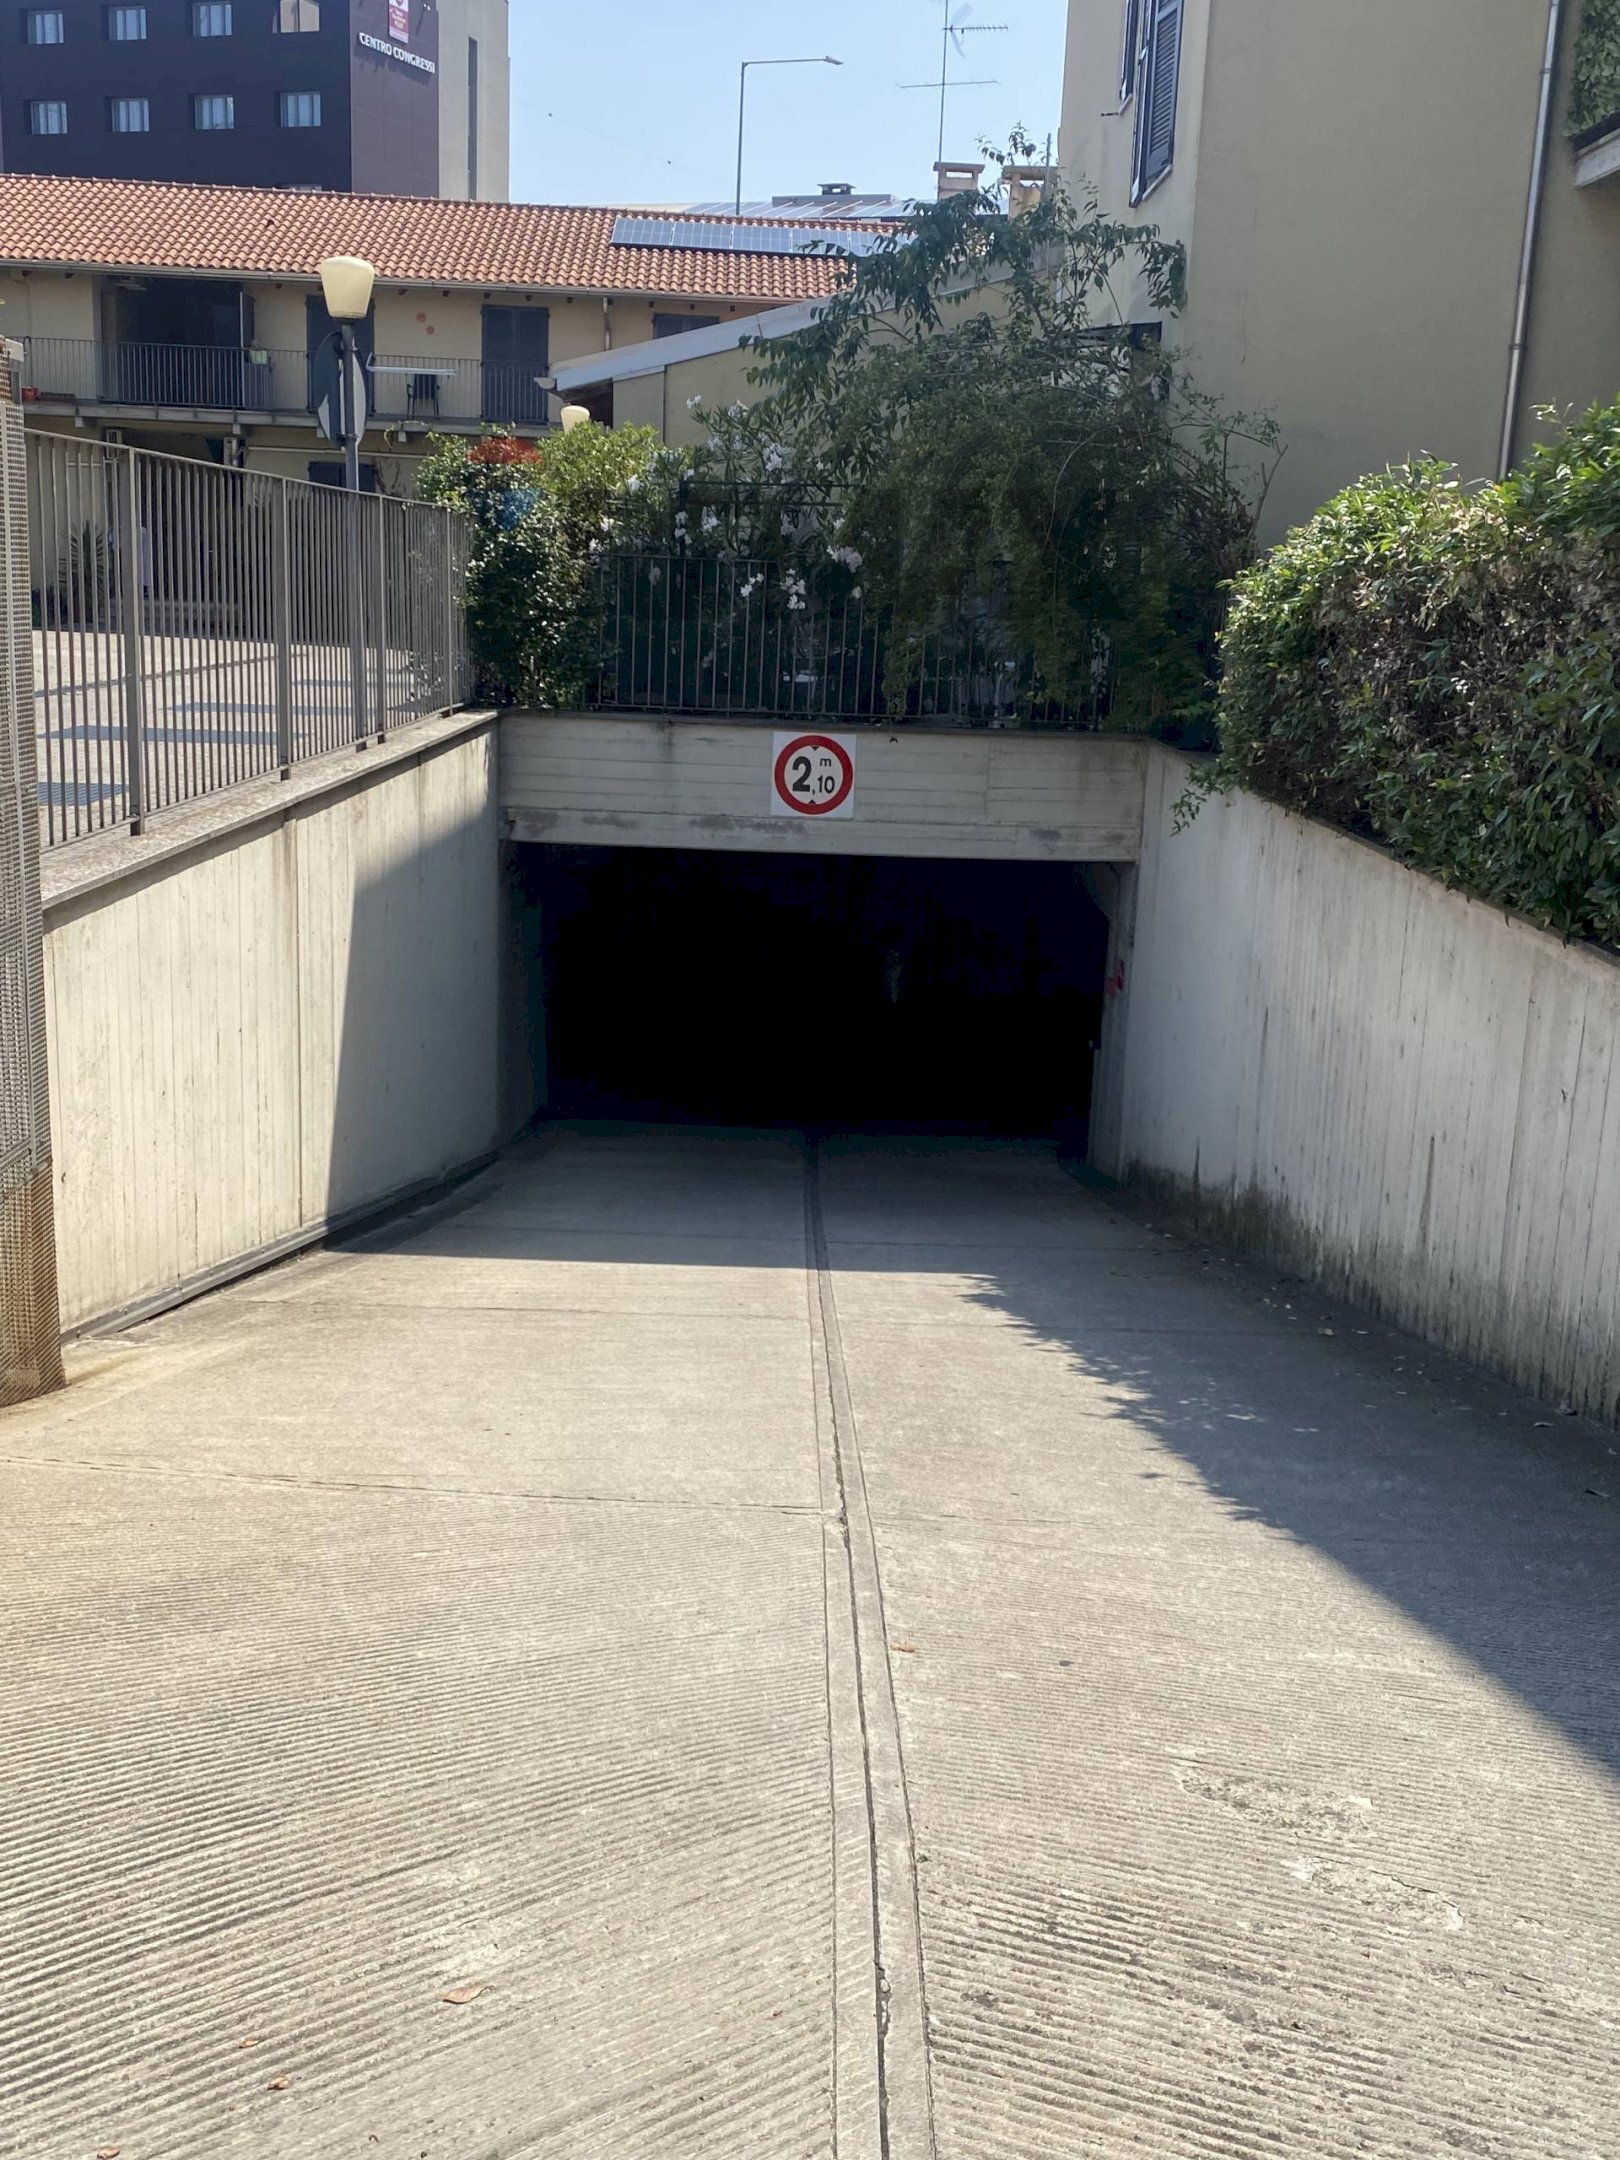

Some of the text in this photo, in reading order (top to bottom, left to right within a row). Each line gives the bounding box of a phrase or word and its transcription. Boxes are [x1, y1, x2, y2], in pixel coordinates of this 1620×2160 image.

[359, 32, 435, 73] CENTRO CONGRESSI
[820, 758, 832, 767] m
